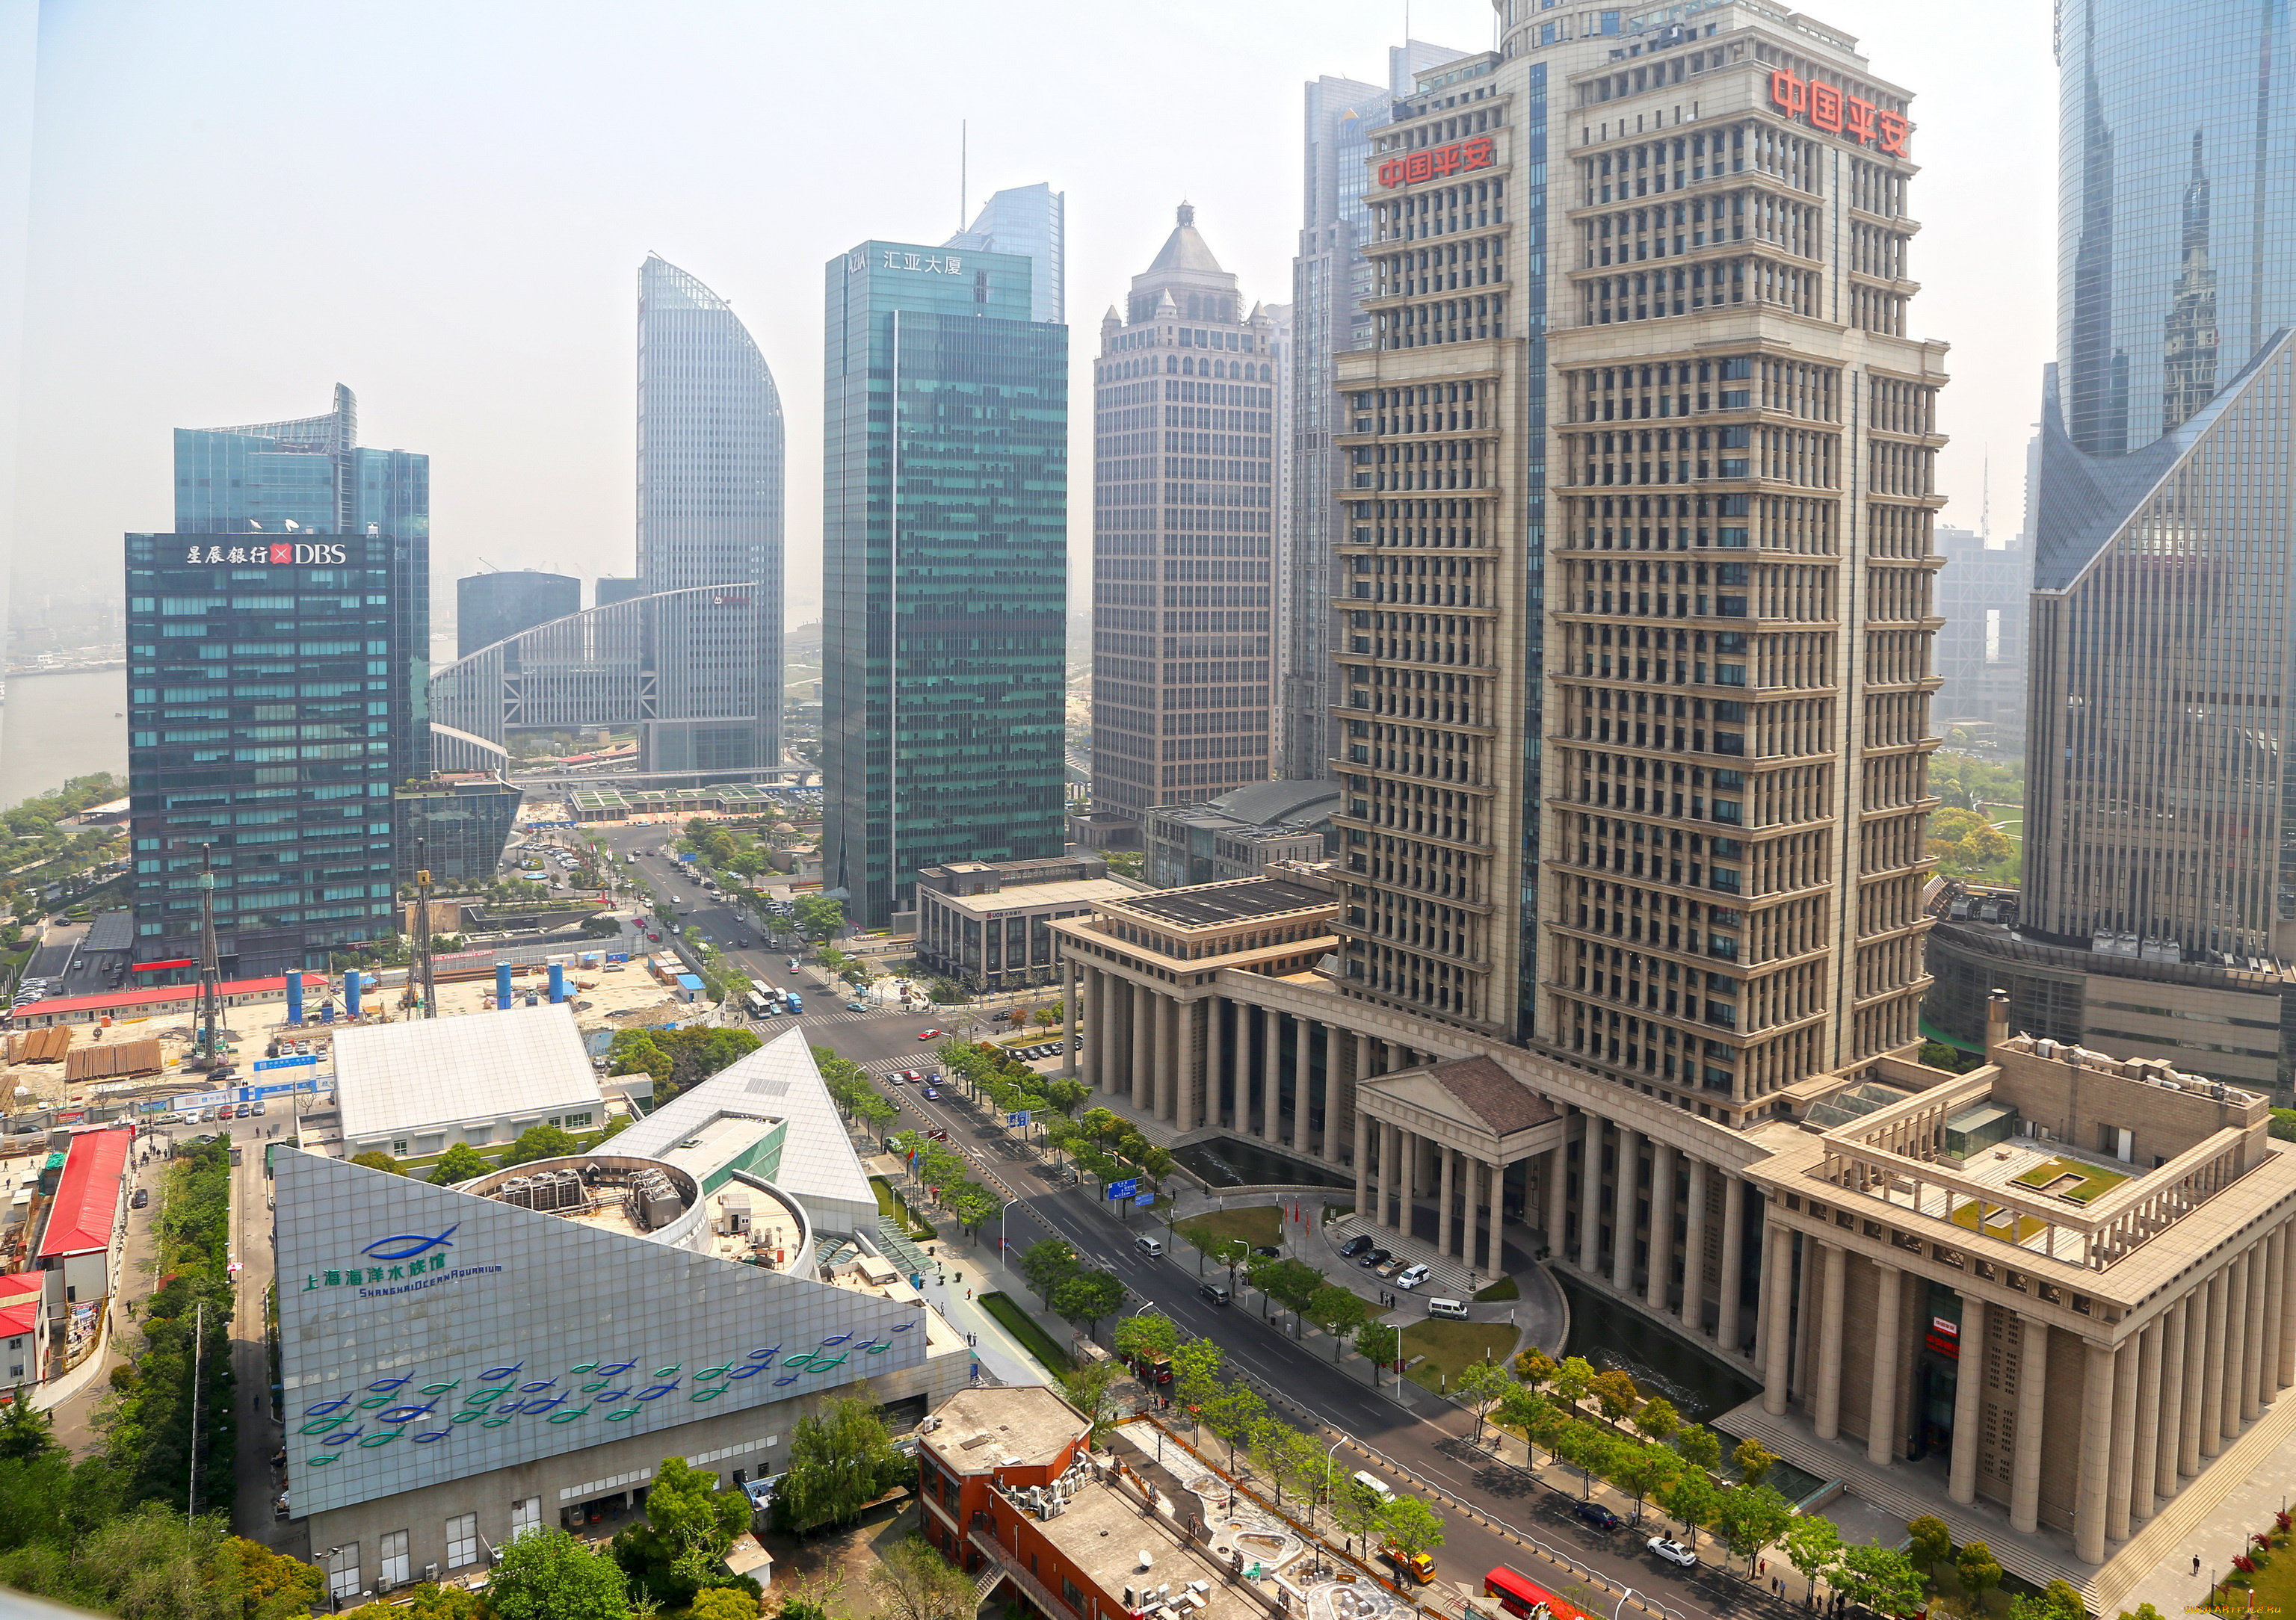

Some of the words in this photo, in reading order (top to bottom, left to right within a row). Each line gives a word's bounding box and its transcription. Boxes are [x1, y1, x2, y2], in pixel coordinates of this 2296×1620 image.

[1771, 68, 1908, 158] 中国平安
[1378, 137, 1493, 188] 中国平安
[848, 250, 866, 275] AZIA
[883, 250, 963, 276] 汇亚大厦
[294, 543, 347, 565] DBS
[302, 1252, 448, 1293] 上海海洋水族馆
